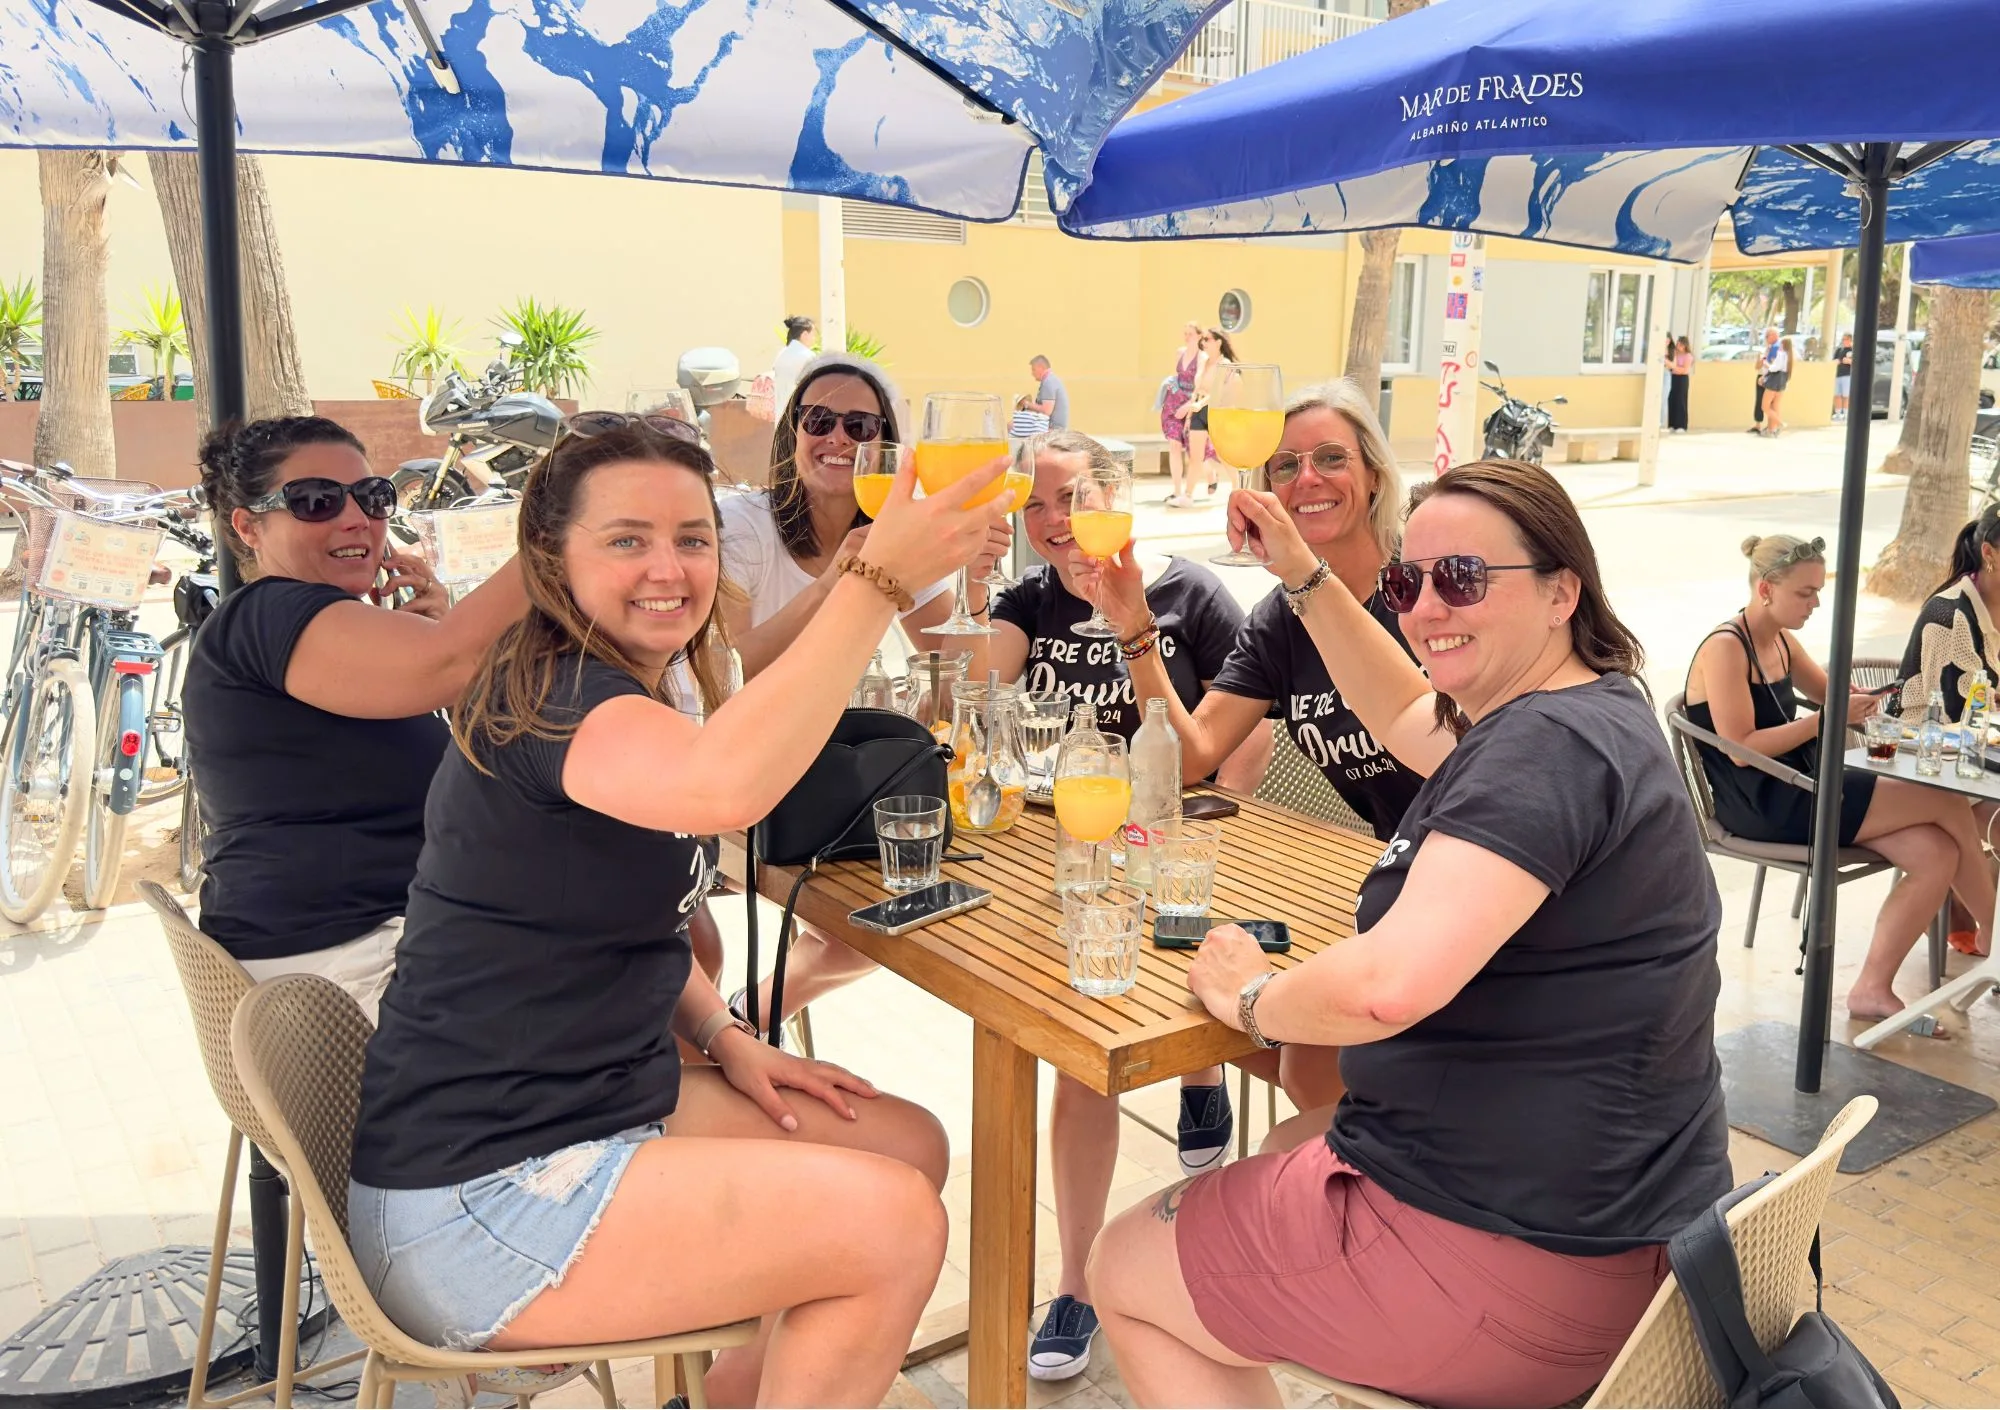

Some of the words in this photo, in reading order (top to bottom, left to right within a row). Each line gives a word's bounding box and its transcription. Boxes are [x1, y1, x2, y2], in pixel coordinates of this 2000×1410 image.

[1400, 86, 1444, 122] MAR
[1446, 84, 1471, 105] DE
[1476, 72, 1584, 105] FRADES
[1410, 120, 1469, 142] ALBARIÑO
[1475, 115, 1548, 131] ATLÁNTICO
[1029, 661, 1137, 706] Drun
[1345, 757, 1398, 781] 07.06.24
